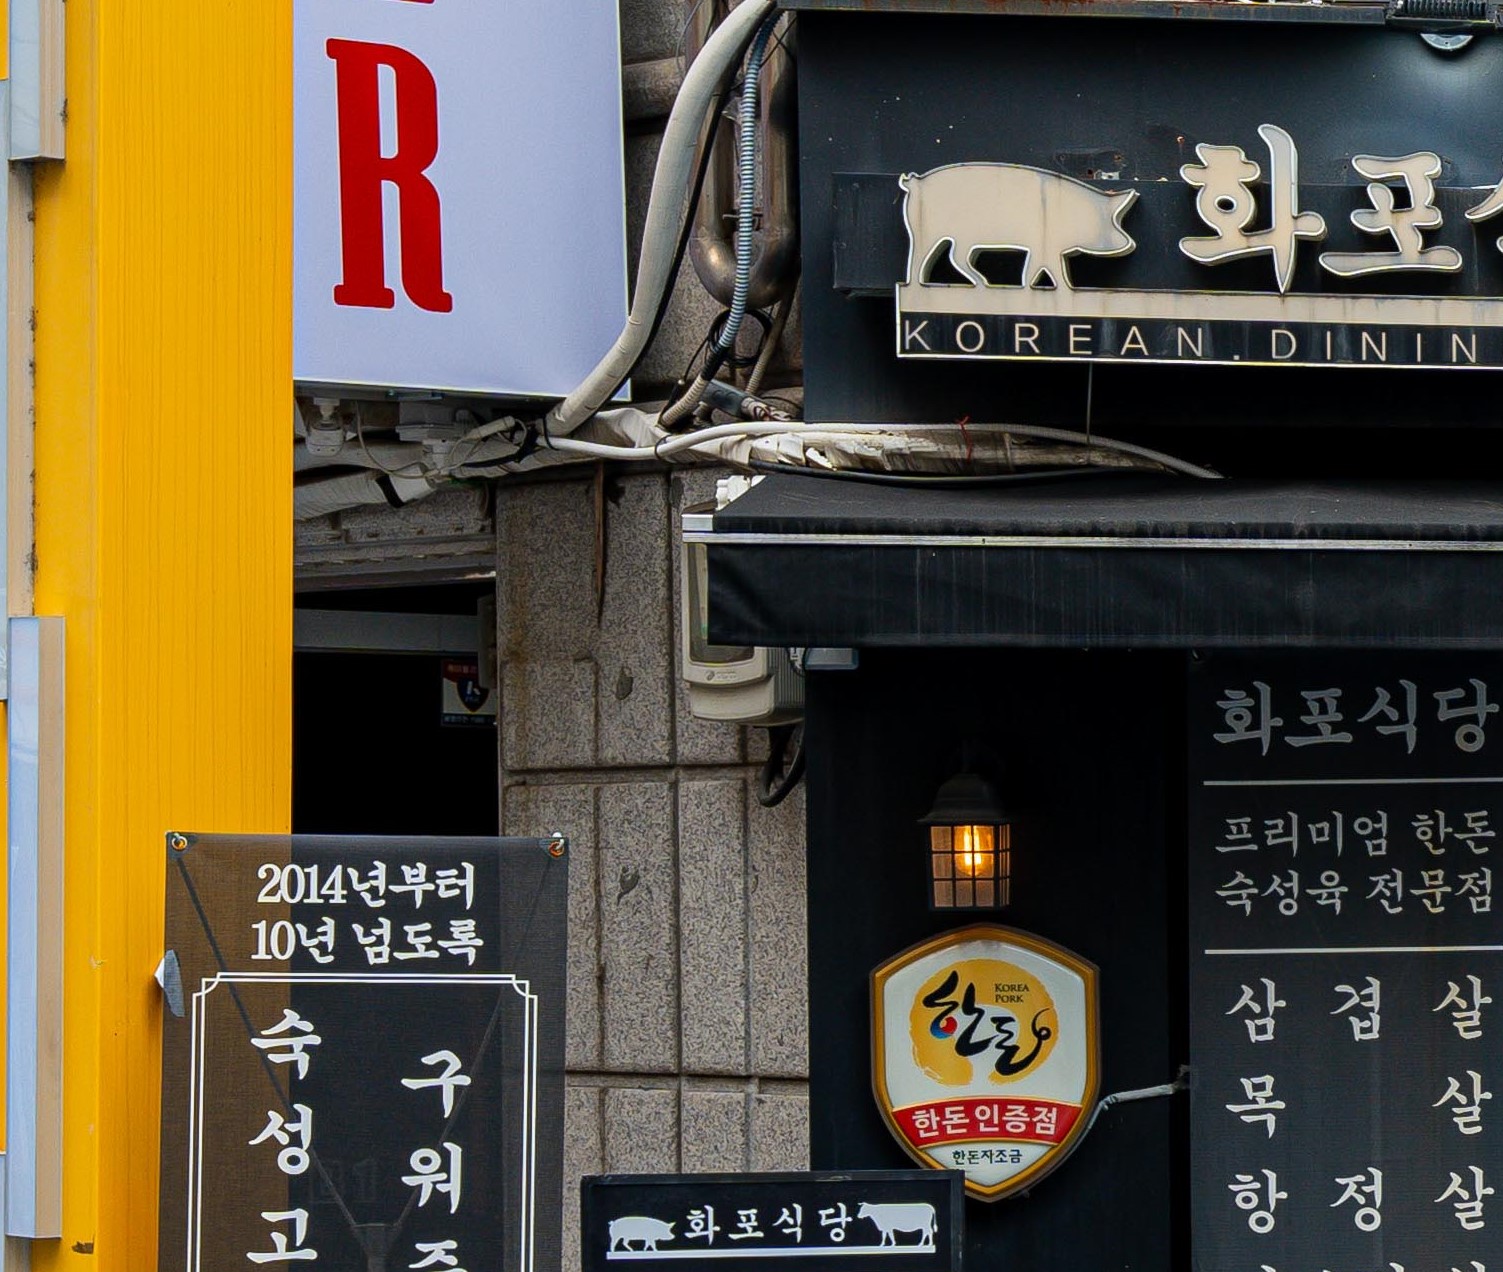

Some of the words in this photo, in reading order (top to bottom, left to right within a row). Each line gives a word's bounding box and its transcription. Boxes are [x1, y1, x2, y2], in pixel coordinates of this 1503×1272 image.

[326, 0, 453, 314] R
[1213, 678, 1499, 755] 화포식당
[1215, 810, 1389, 857] 프리미엄
[1411, 809, 1496, 855] 한돈
[256, 861, 475, 910] 2014년부터
[1215, 869, 1349, 917] 숙성육
[1365, 867, 1493, 914] 전문점
[251, 917, 335, 963] 10년
[352, 917, 483, 965] 넘도록
[952, 1149, 1023, 1165] 한돈자조금
[683, 1202, 853, 1246] 화포식당
